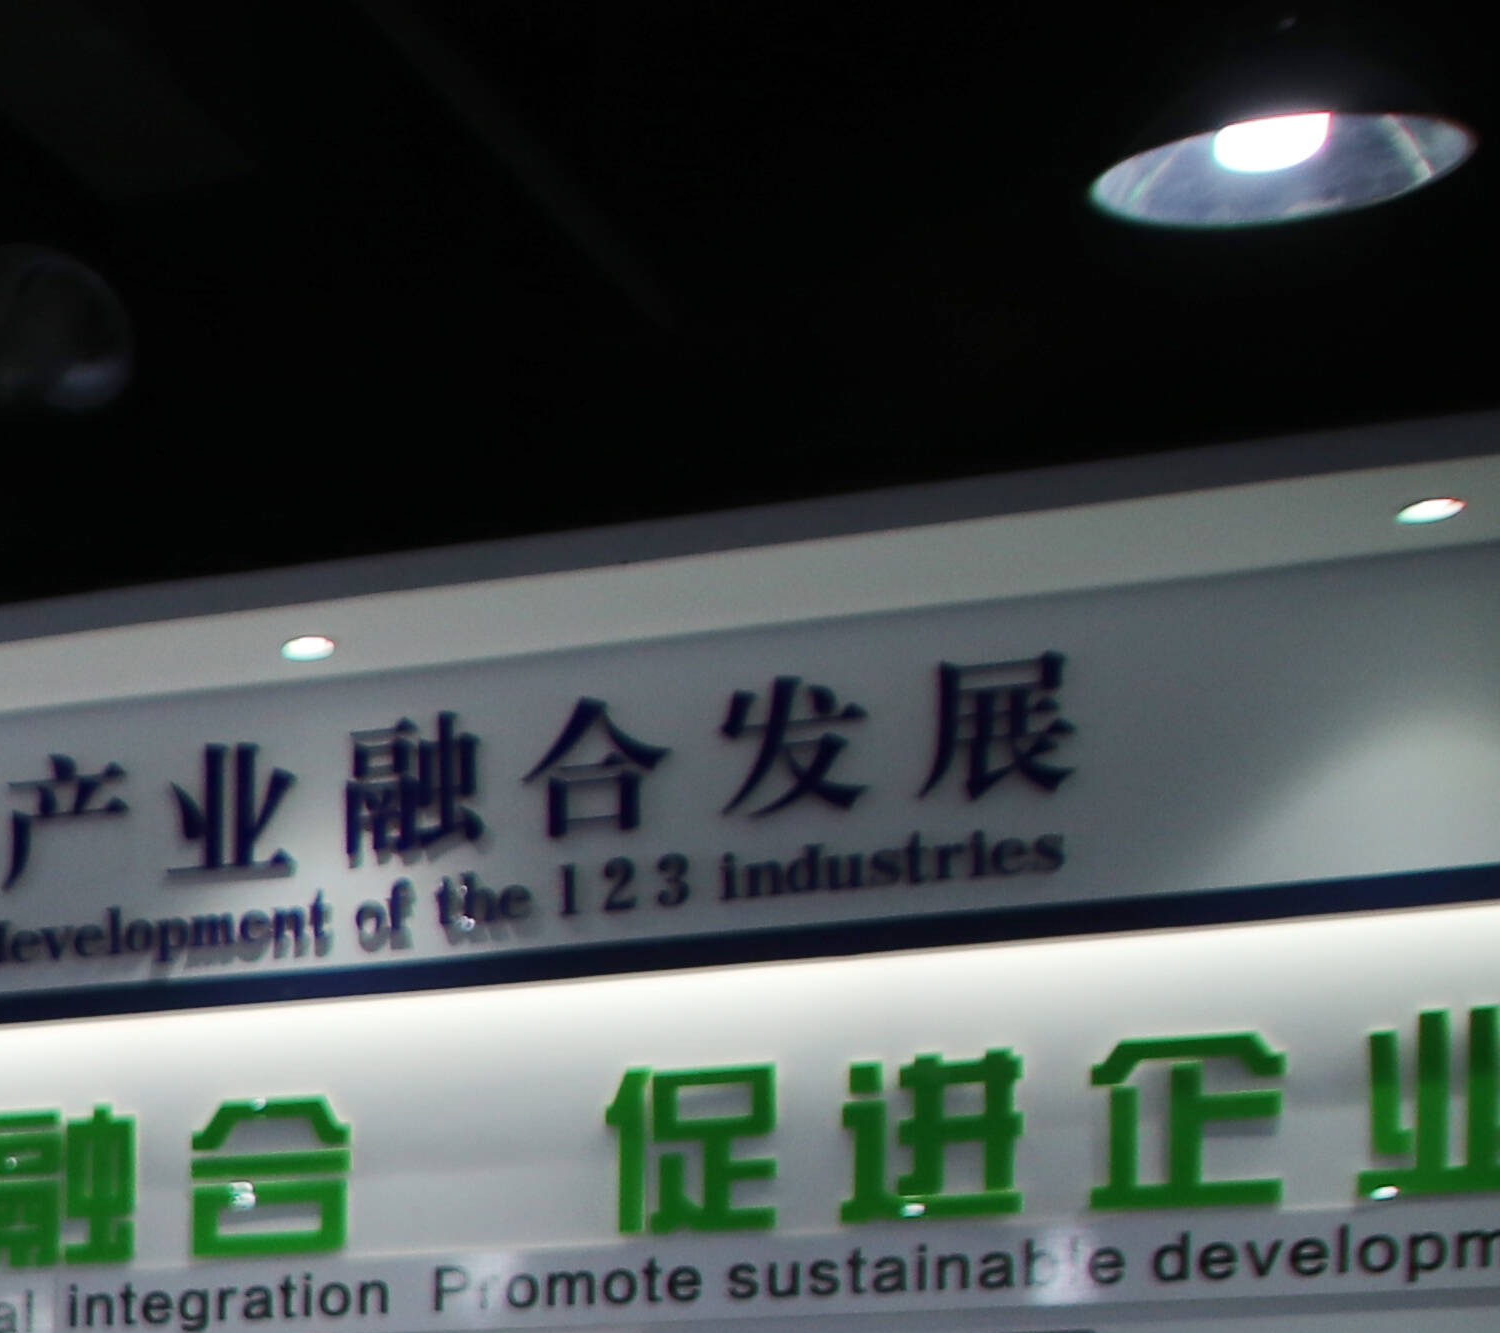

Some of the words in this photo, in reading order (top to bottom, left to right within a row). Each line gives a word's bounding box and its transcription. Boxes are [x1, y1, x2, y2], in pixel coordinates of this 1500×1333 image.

[355, 878, 414, 936] of
[436, 868, 533, 934] the
[719, 829, 1067, 902] industries
[66, 1269, 391, 1331] integration
[432, 1253, 702, 1316] Promote
[727, 1235, 1127, 1300] sustainable
